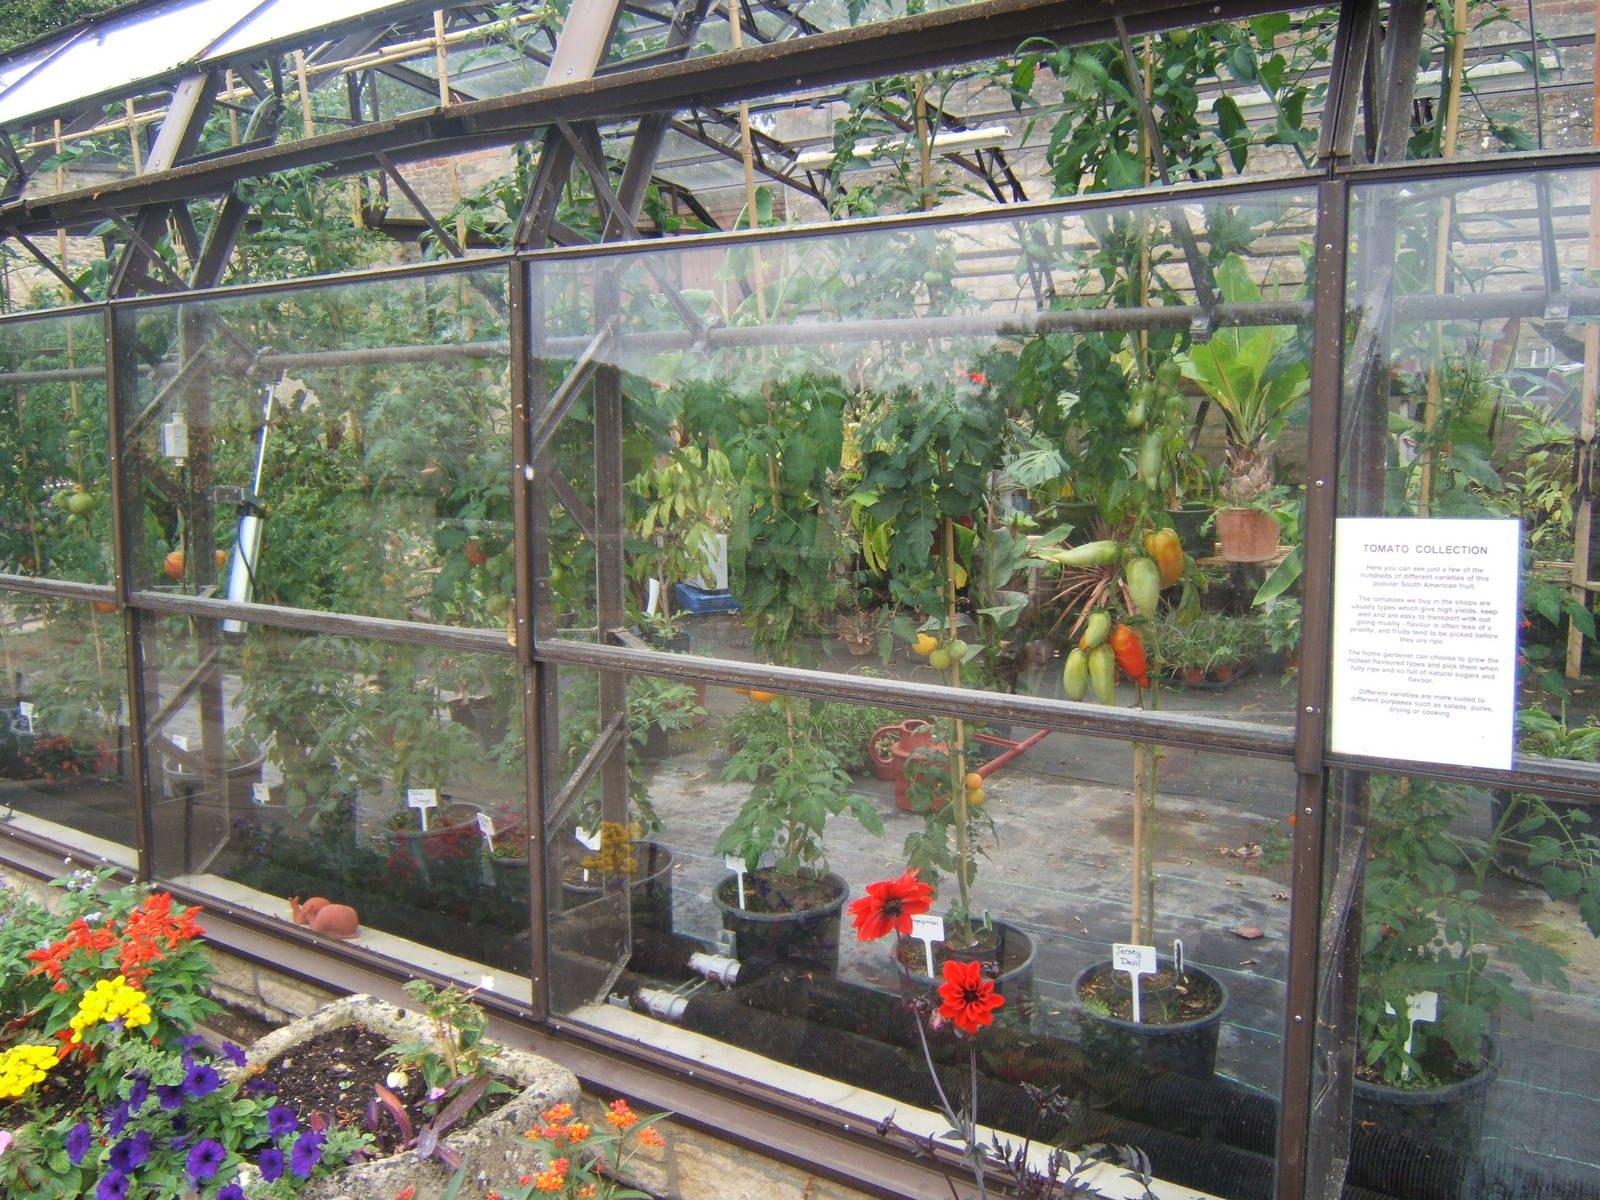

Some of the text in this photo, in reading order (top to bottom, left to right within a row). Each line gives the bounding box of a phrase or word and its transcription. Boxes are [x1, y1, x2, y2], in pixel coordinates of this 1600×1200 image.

[1364, 545, 1488, 554] TOMATO COLLECTION
[1116, 946, 1141, 958] Jersey
